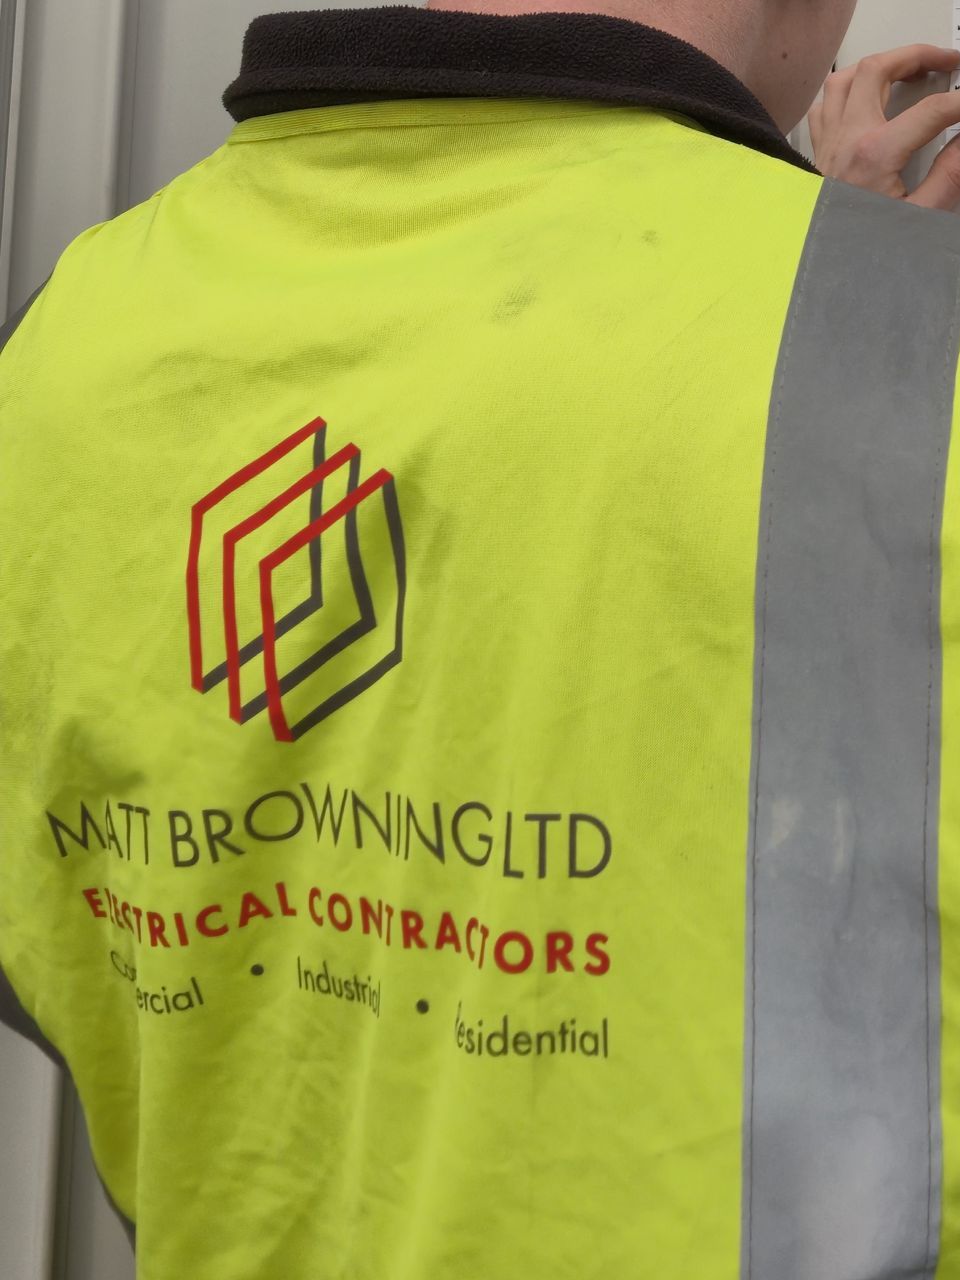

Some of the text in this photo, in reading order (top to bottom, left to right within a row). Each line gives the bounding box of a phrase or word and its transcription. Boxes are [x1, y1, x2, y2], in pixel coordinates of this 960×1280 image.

[46, 799, 151, 866] MATT
[81, 881, 612, 977] ELECTRICAL CONTRACTORS
